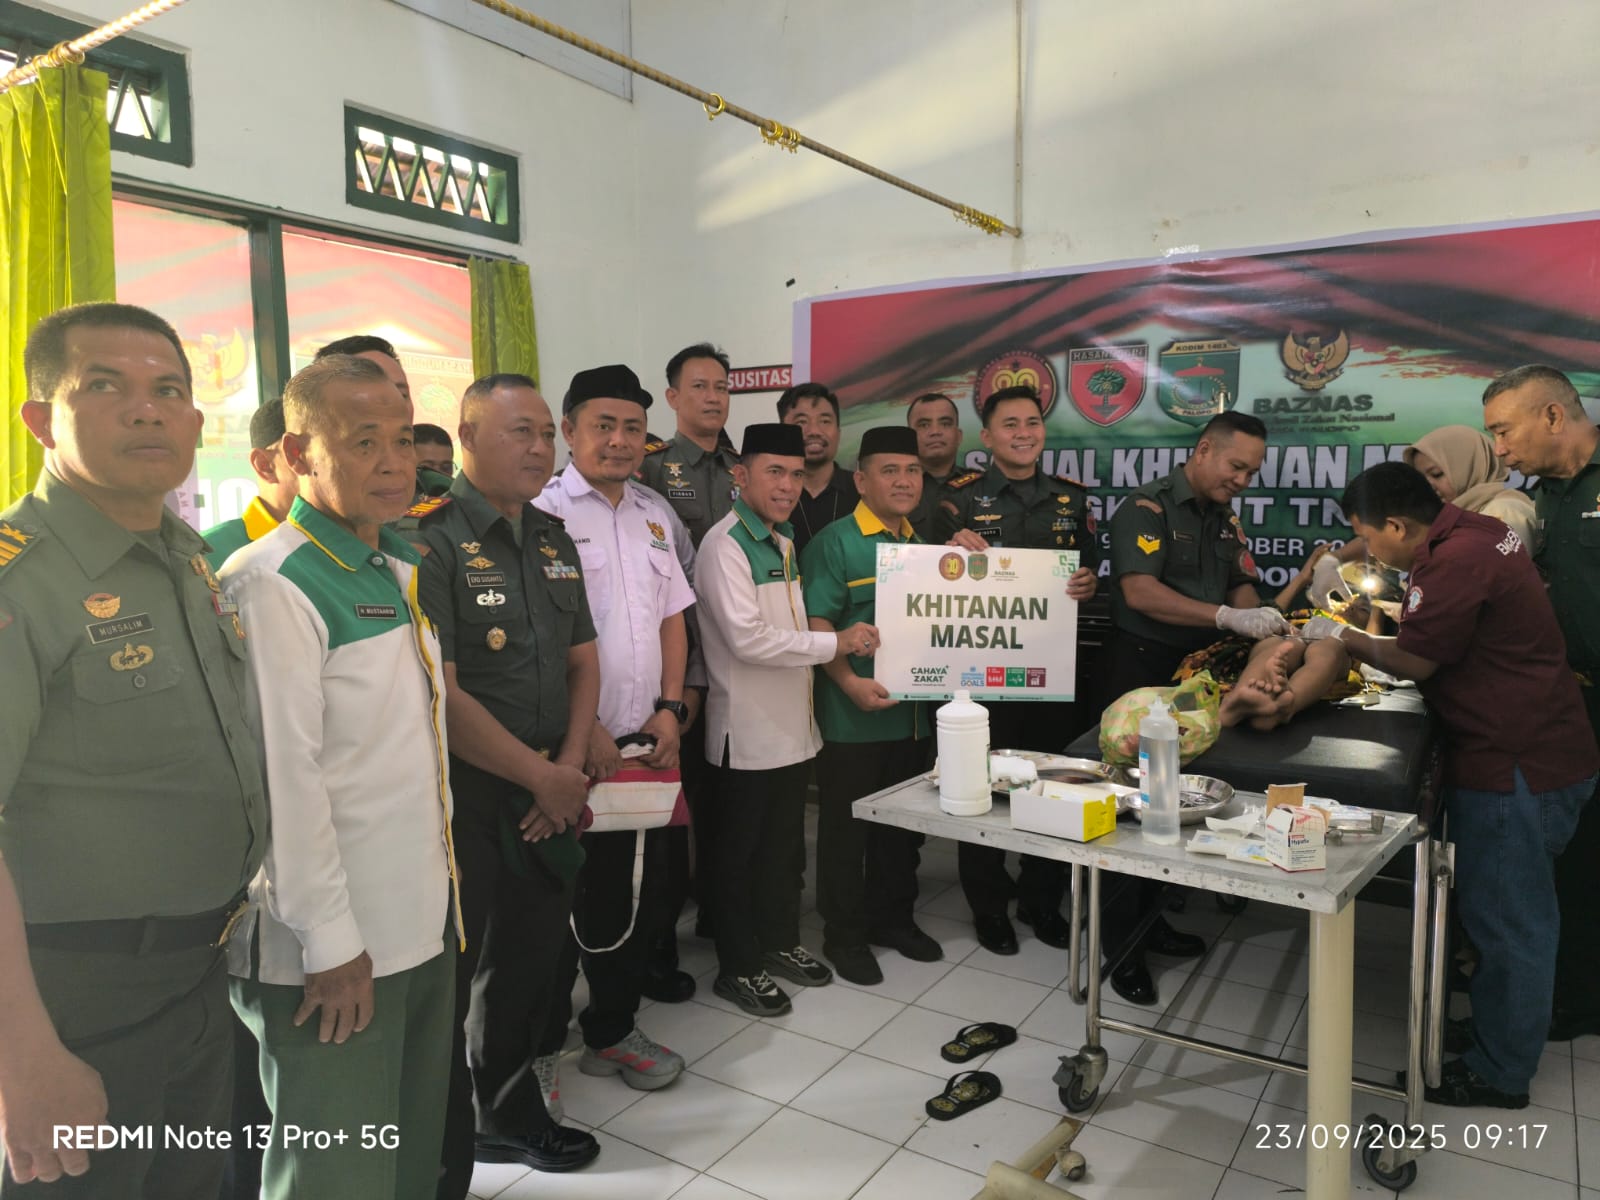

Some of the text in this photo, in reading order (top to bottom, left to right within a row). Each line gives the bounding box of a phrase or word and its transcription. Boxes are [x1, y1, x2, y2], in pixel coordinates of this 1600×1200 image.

[1253, 394, 1373, 414] BAZNAS
[1112, 446, 1348, 489] KHINAN
[906, 593, 1049, 621] KHITANAN
[930, 623, 1024, 650] MASAL
[910, 666, 948, 675] CAHAYA
[913, 675, 944, 683] ZAKAT
